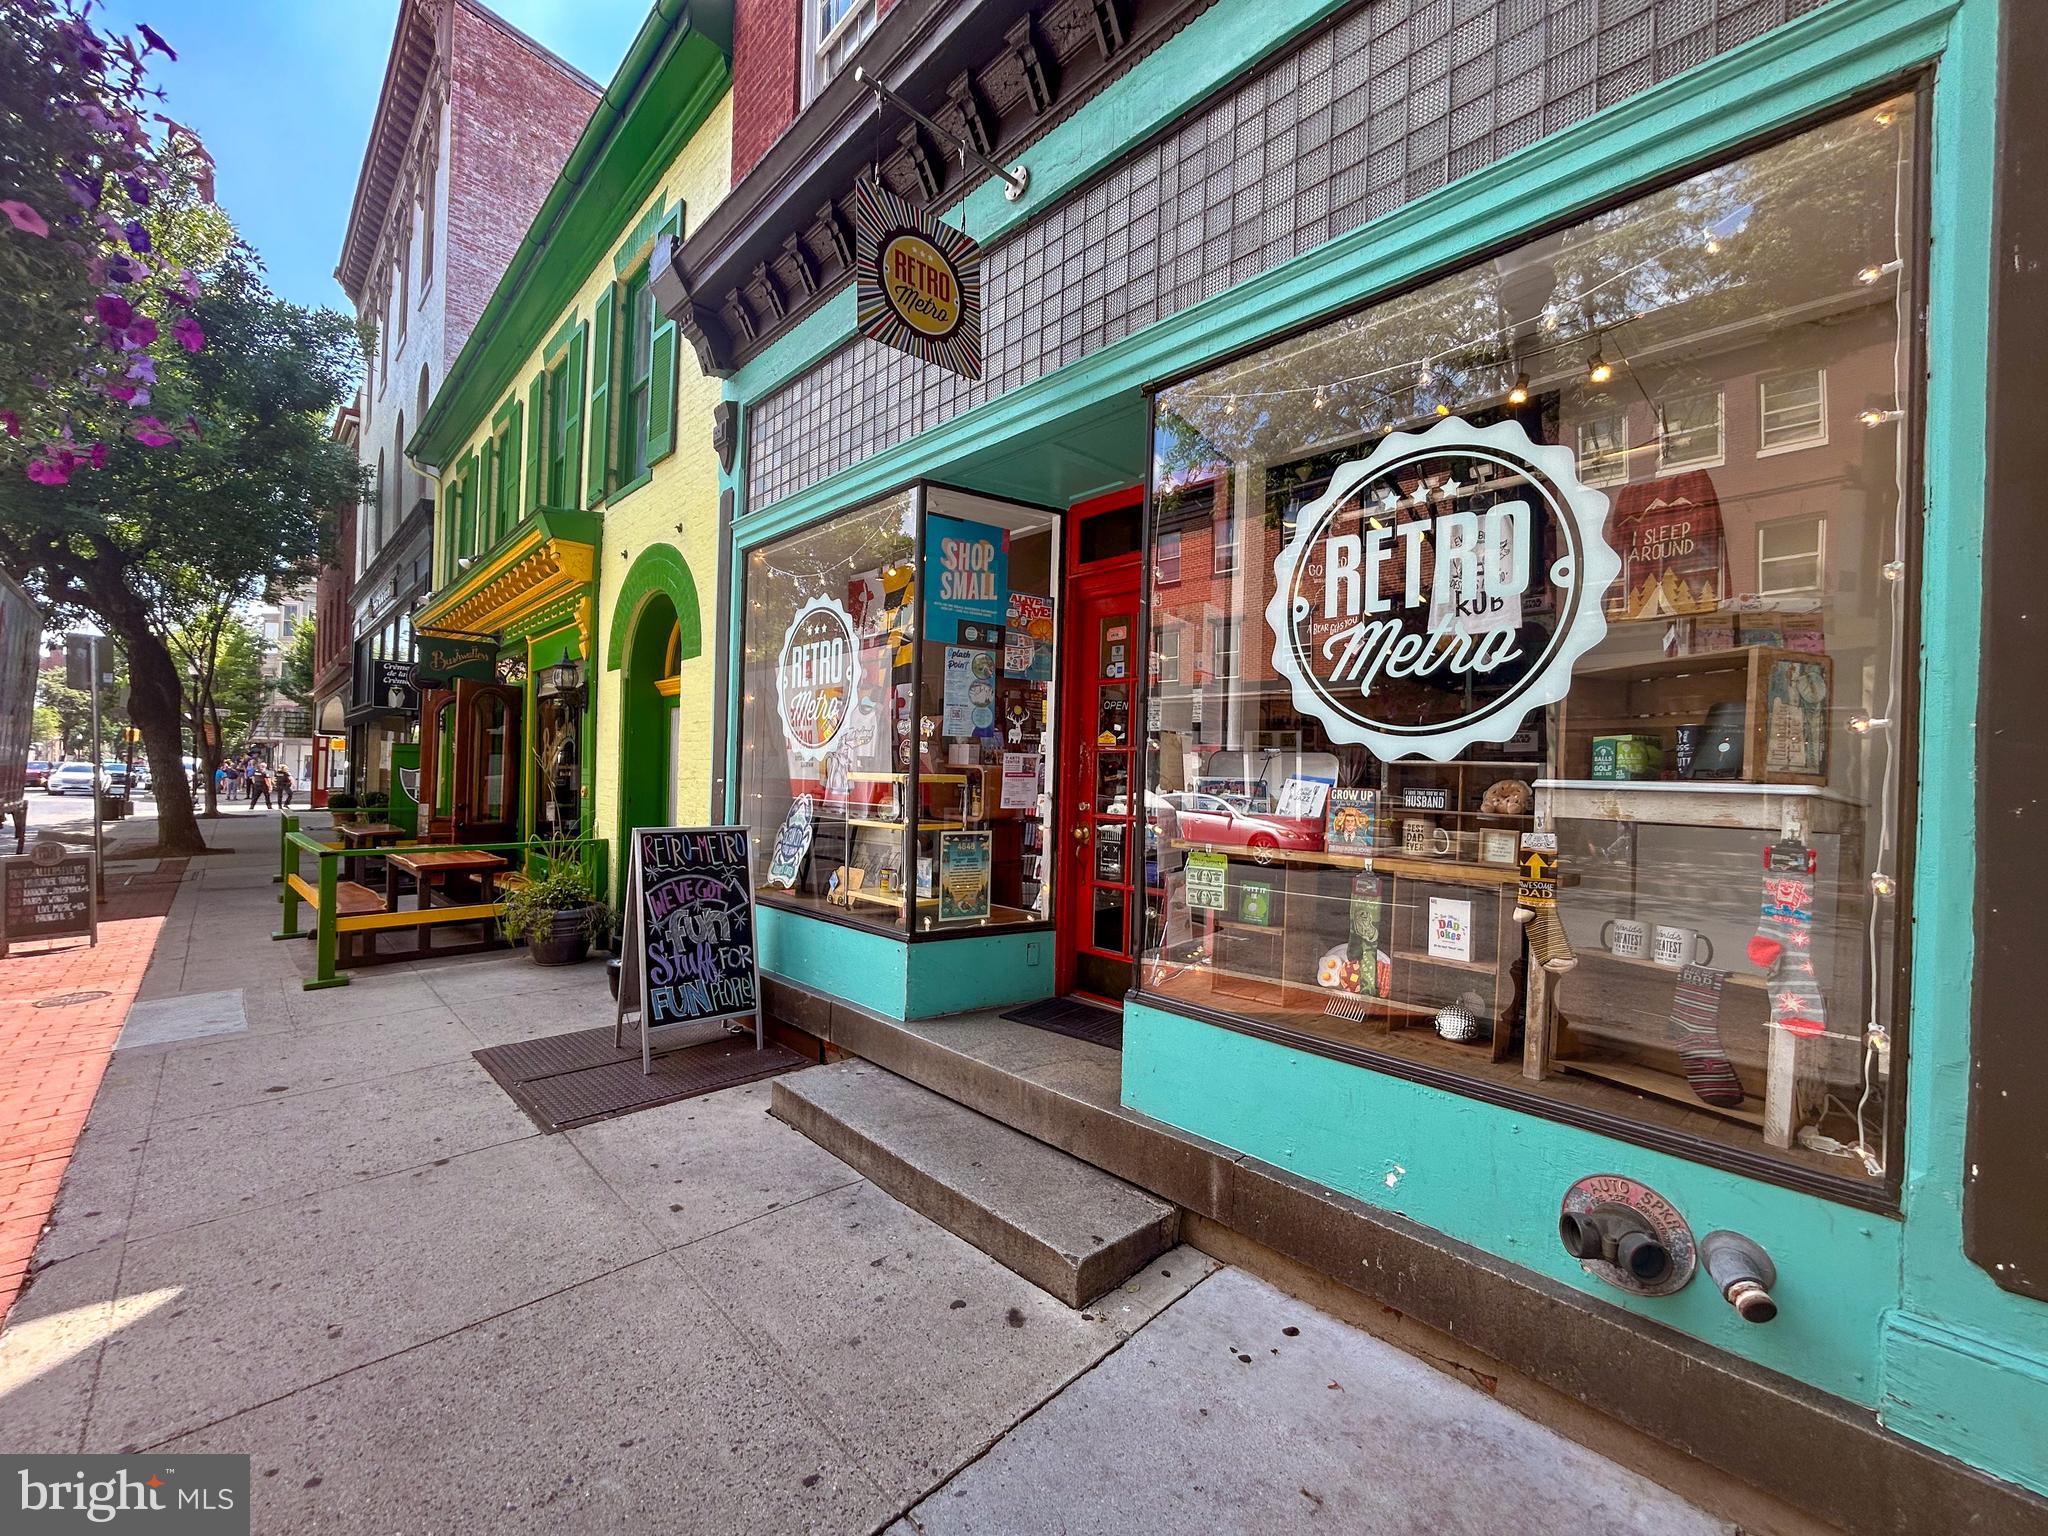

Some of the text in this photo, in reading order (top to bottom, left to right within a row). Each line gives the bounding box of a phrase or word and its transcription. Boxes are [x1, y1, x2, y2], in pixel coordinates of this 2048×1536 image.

[895, 248, 950, 303] RETRO
[895, 285, 948, 323] Metro
[1628, 539, 1695, 562] AROUND
[1632, 522, 1691, 546] I SLEEP
[940, 537, 995, 572] SHOP
[1325, 500, 1530, 619] RETRO
[940, 570, 998, 601] SMALL
[1344, 617, 1358, 629] YOU
[791, 636, 843, 689] RETRO
[1322, 614, 1523, 698] Metro
[790, 688, 838, 728] Metro
[1103, 700, 1129, 711] OPEN
[1331, 789, 1374, 801] GROW UP
[1405, 796, 1444, 808] HUSBAND
[643, 832, 746, 867] RETRO-METRO
[1406, 833, 1424, 841] DAD
[1406, 843, 1424, 851] EVER
[650, 879, 723, 917] WE'VE GOT
[1518, 887, 1553, 898] DAD
[665, 908, 732, 952] fun
[1438, 919, 1460, 931] DAD
[648, 940, 753, 986] Stuff FOR
[650, 980, 715, 1020] FUN
[1590, 1179, 1682, 1232] AUTO SPKR
